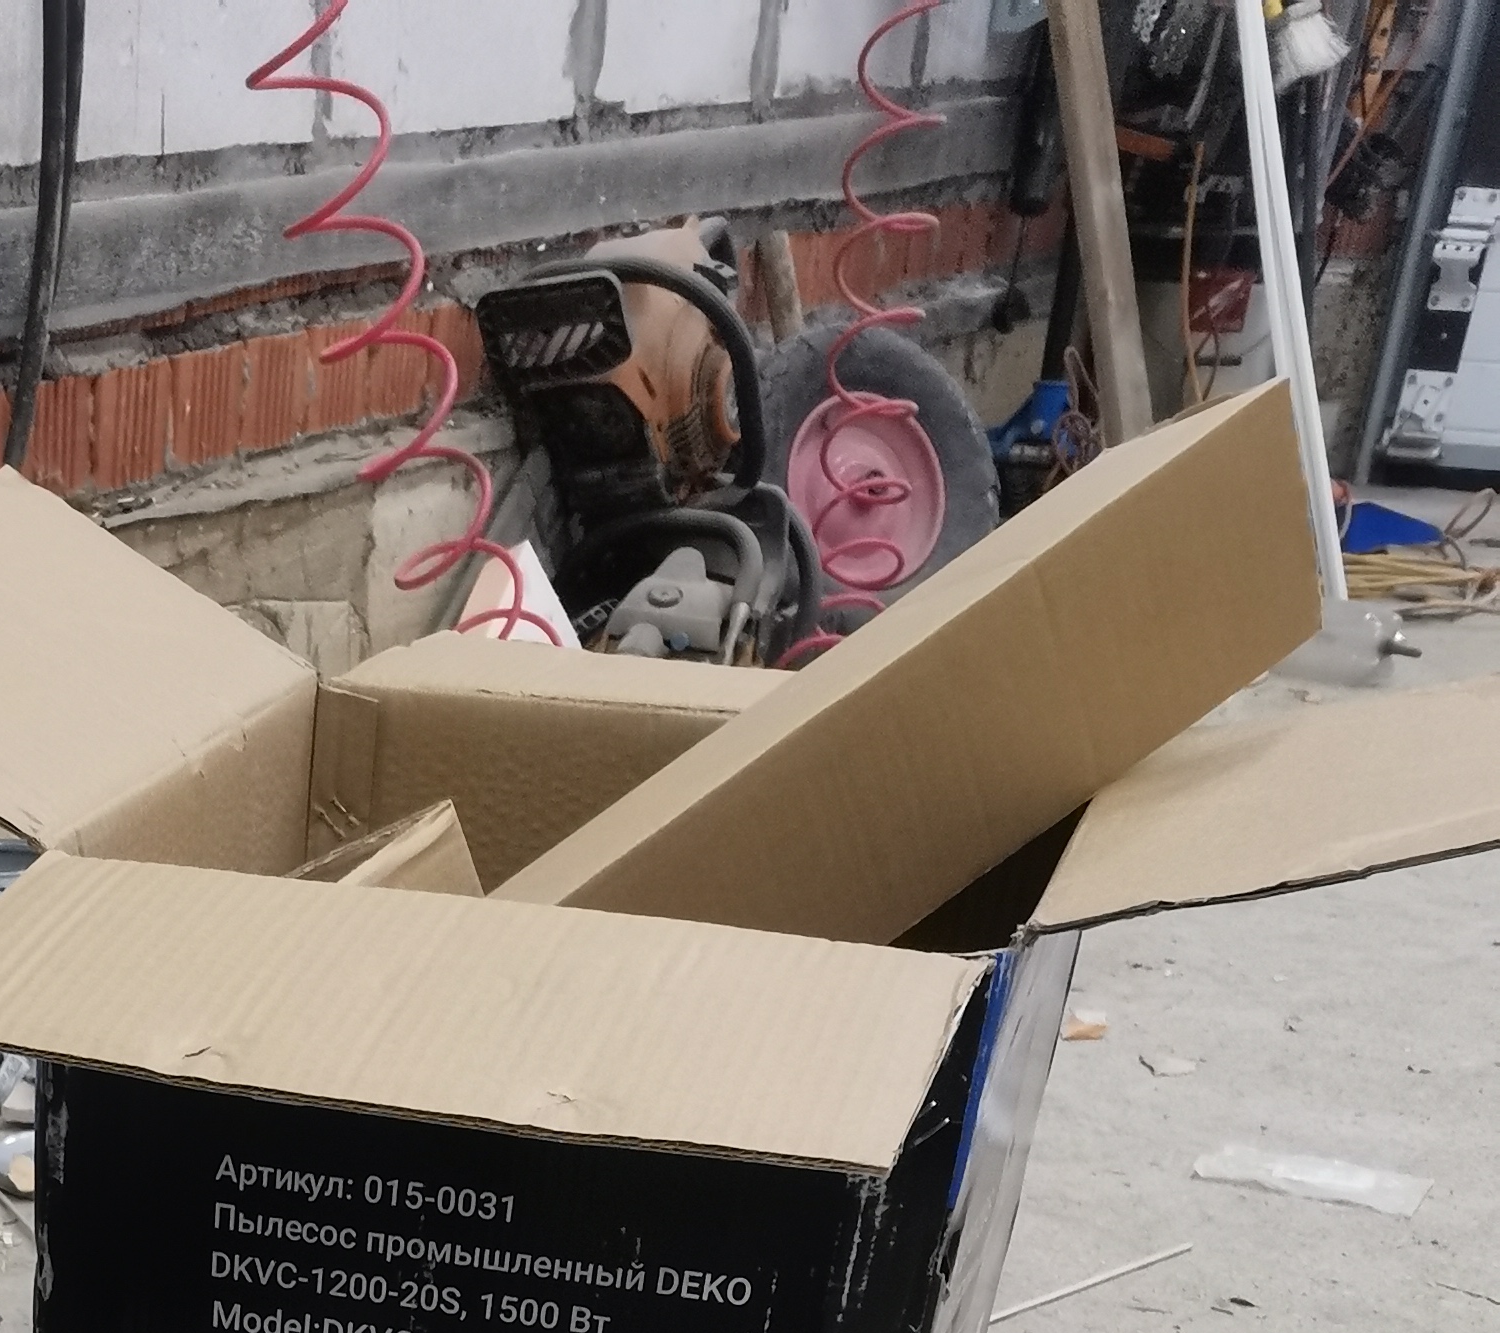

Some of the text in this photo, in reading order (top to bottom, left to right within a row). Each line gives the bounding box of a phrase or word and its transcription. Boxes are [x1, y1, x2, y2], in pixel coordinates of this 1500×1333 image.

[214, 1153, 515, 1224] Артикул: 015-0031
[210, 1250, 468, 1322] DKVC-1200-20S,
[480, 1292, 561, 1330] 1500
[213, 1201, 753, 1307] Пылесос промышленный DEKO
